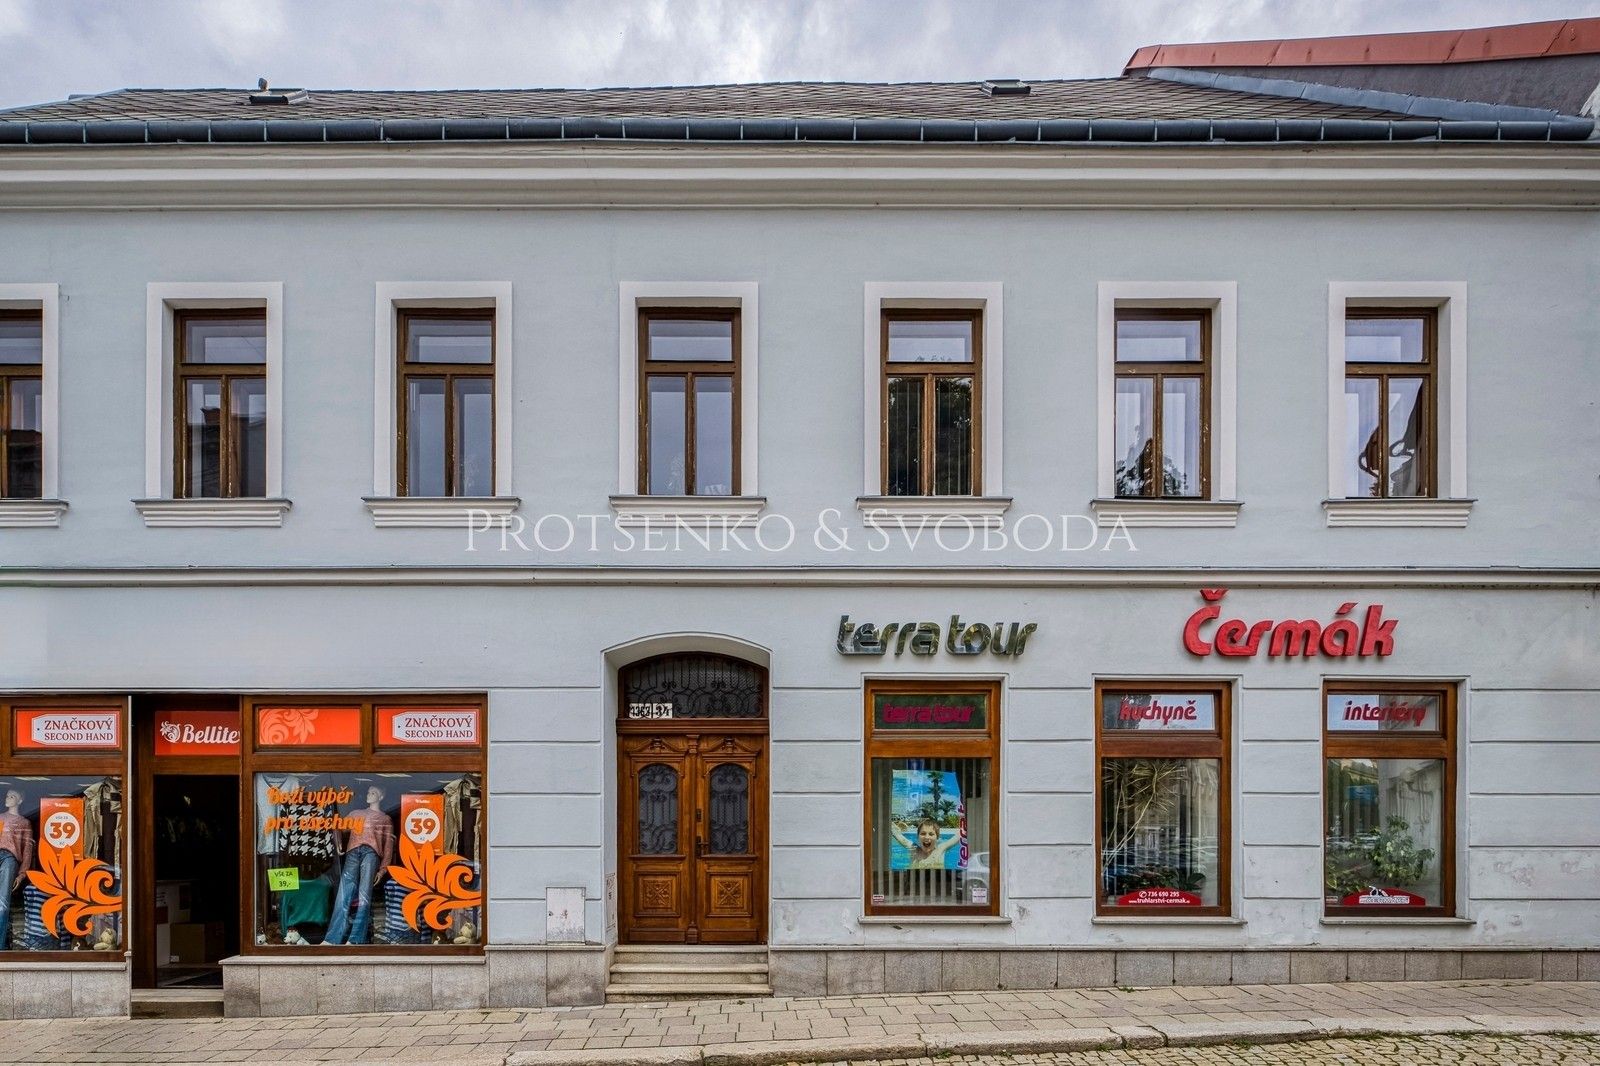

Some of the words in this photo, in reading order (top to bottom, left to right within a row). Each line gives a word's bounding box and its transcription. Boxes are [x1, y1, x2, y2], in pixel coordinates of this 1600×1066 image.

[1183, 588, 1399, 657] Čermák
[836, 615, 940, 656] terra
[945, 615, 1038, 656] tour
[1118, 699, 1198, 725] kuchyně
[1343, 700, 1427, 727] interiéry
[44, 717, 114, 731] ZNAČKOVÝ
[404, 715, 473, 728] ZNAČKOVÝ
[44, 733, 83, 741] SECOND
[86, 733, 113, 741] HAND
[182, 723, 240, 744] Bellite
[404, 730, 443, 738] SECOND
[446, 730, 473, 738] HAND
[49, 822, 76, 839] 39
[410, 818, 436, 835] 39
